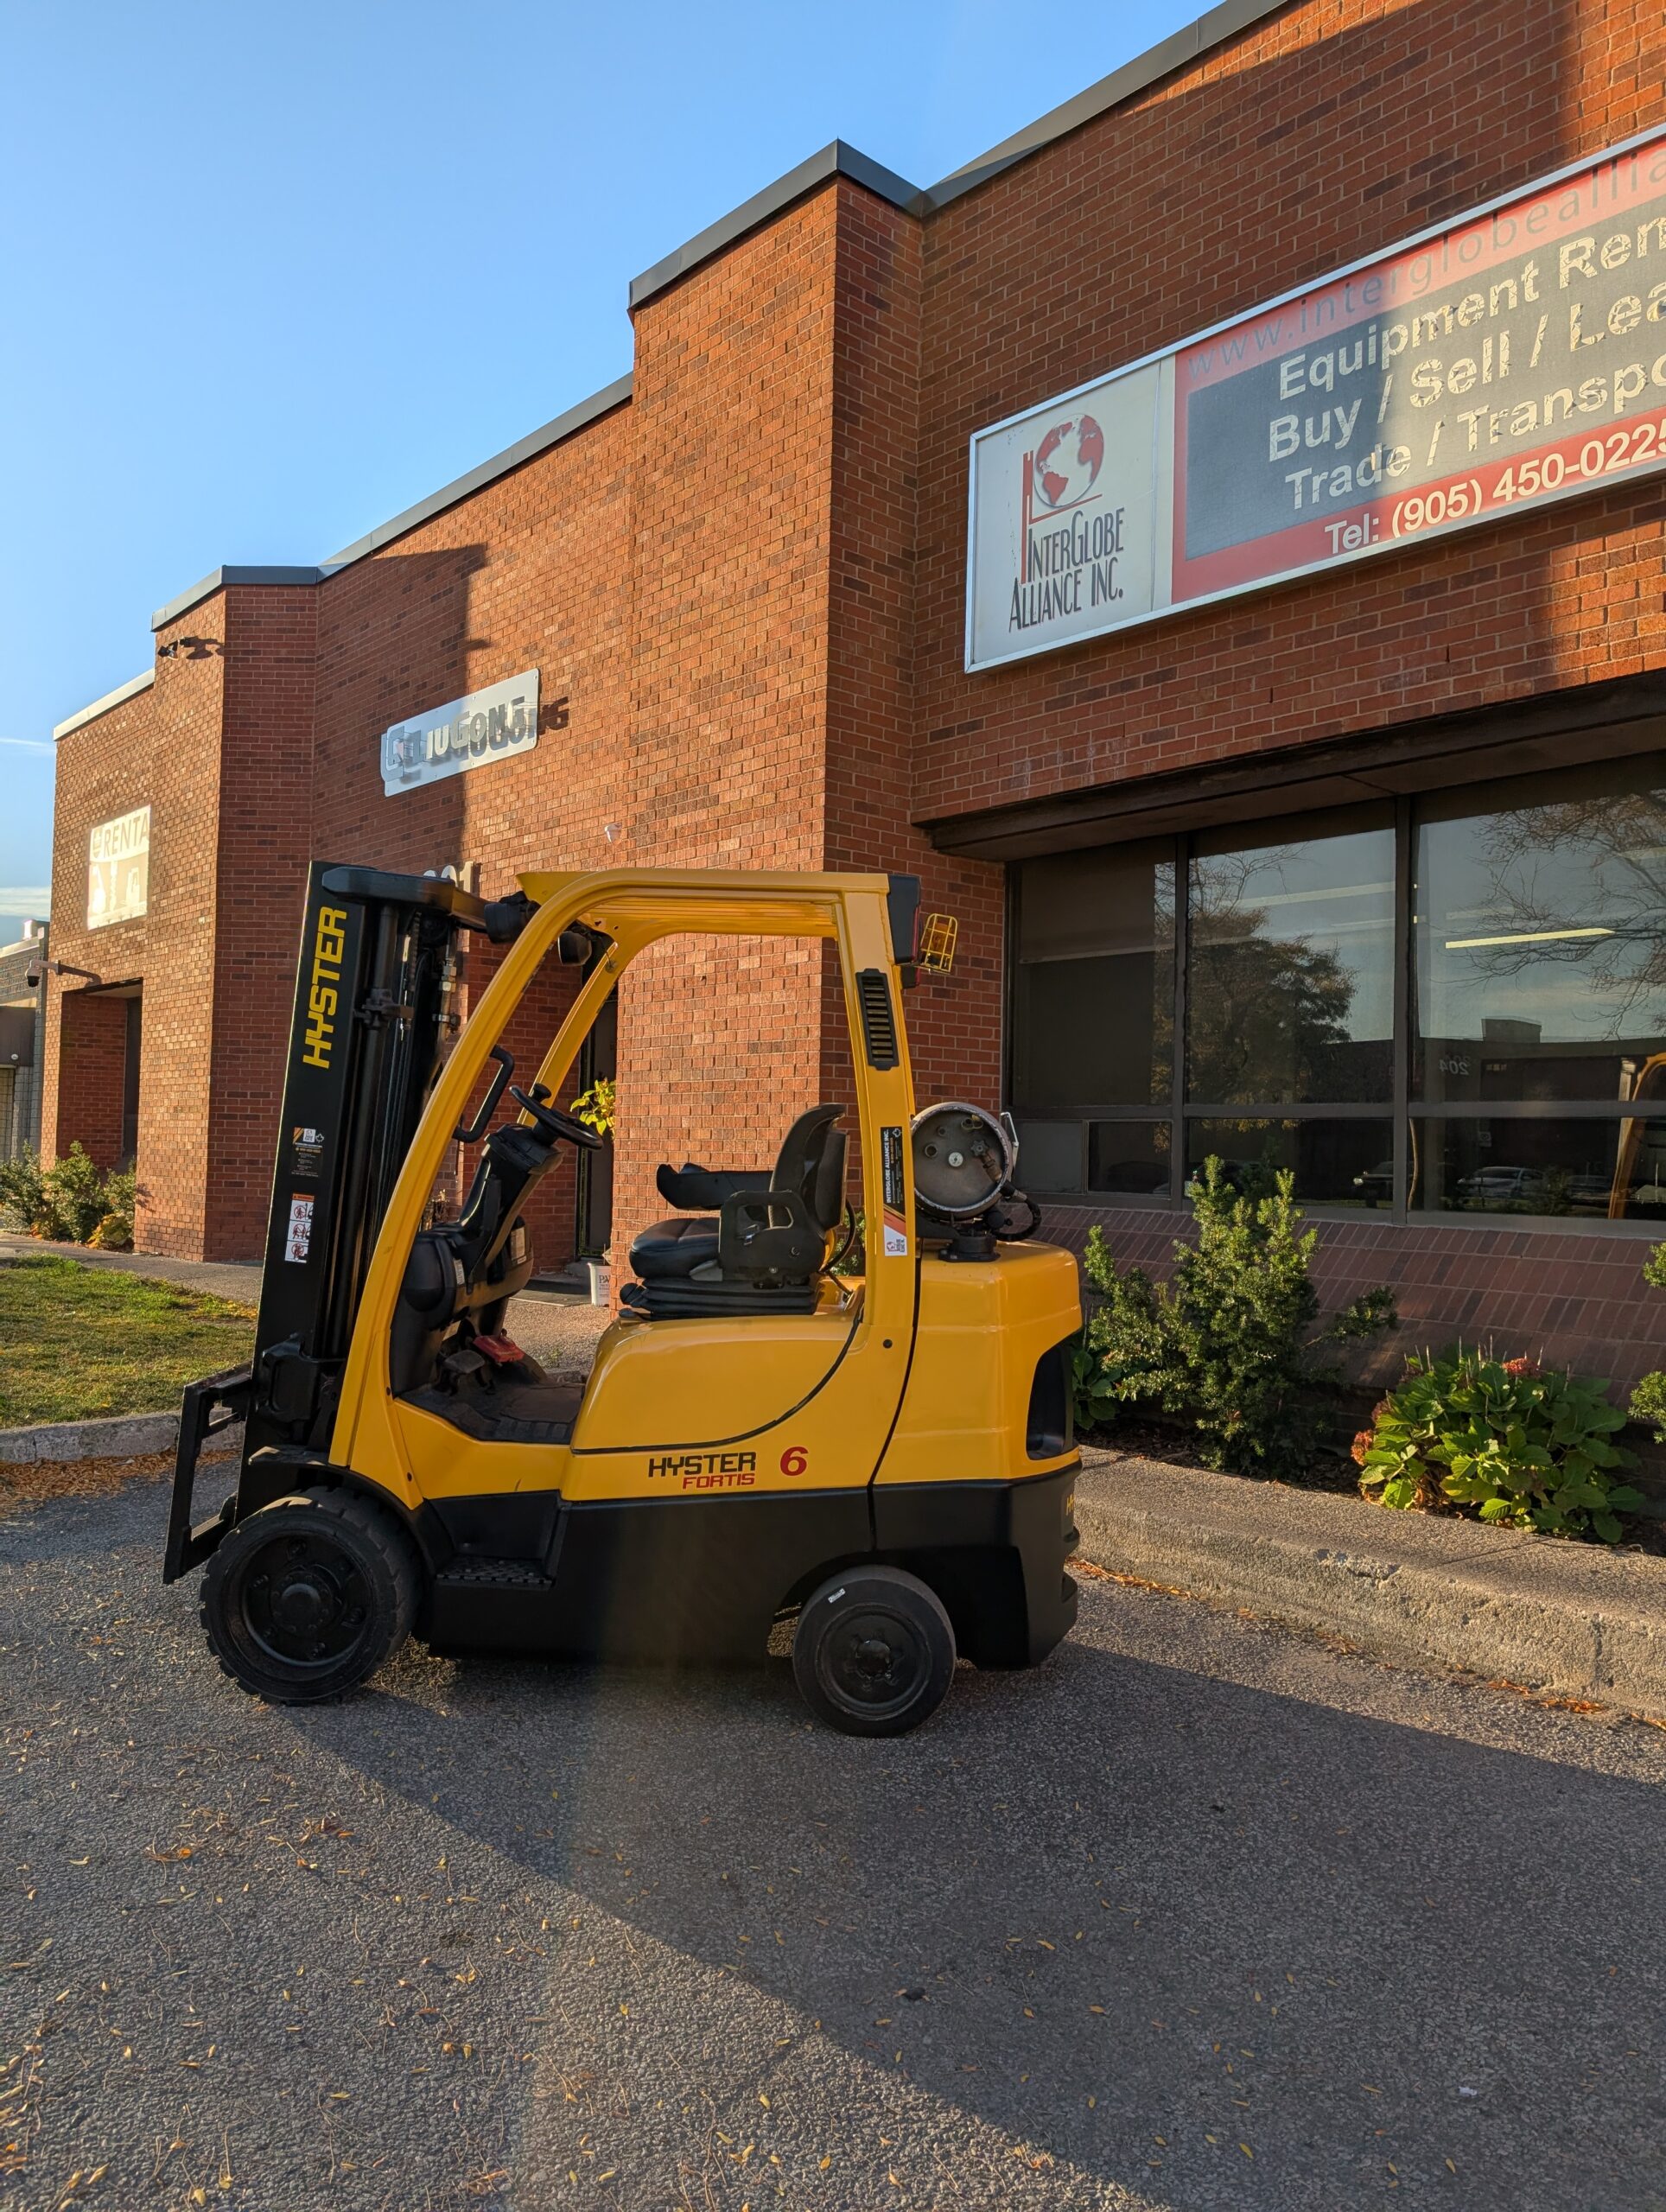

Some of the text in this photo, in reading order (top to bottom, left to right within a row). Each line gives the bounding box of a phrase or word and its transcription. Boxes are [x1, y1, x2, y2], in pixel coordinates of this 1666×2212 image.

[1280, 217, 1666, 401] Equipment Ren
[1269, 398, 1363, 462] Buy
[1377, 374, 1393, 424] /
[1409, 330, 1511, 408] Sell
[1529, 313, 1549, 368] /
[1285, 442, 1411, 510] Trade
[1427, 420, 1445, 467] /
[1324, 512, 1380, 555] Tel:
[1391, 479, 1483, 538] (905)
[1091, 556, 1124, 607] INC.
[302, 906, 347, 1070] HYSTER
[648, 1446, 810, 1478] HYSTER 6
[682, 1472, 755, 1490] FORTIS
